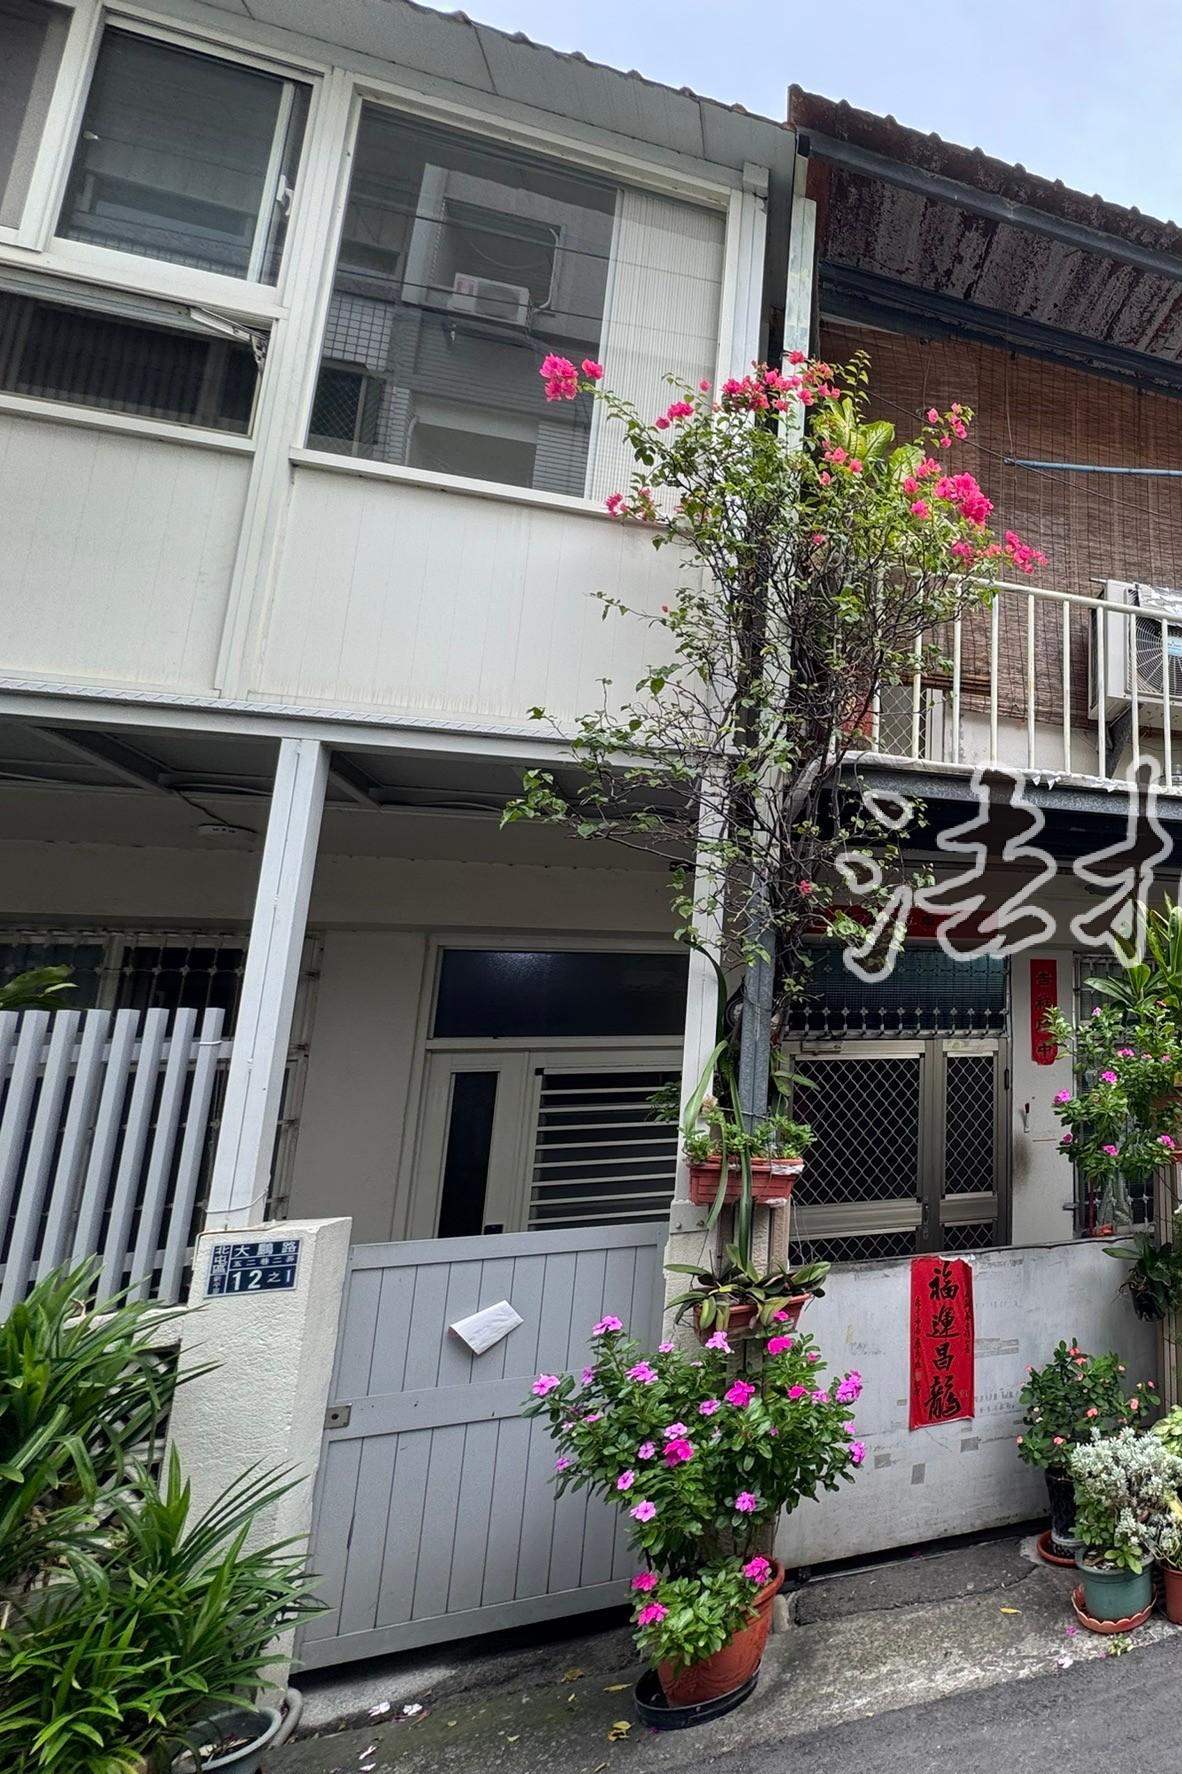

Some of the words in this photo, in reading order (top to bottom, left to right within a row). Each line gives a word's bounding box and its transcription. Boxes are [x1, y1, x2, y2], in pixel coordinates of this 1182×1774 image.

[212, 1245, 230, 1275] 北屯區
[234, 1241, 297, 1257] 大鵬路
[924, 1260, 961, 1421] 福運昌龍
